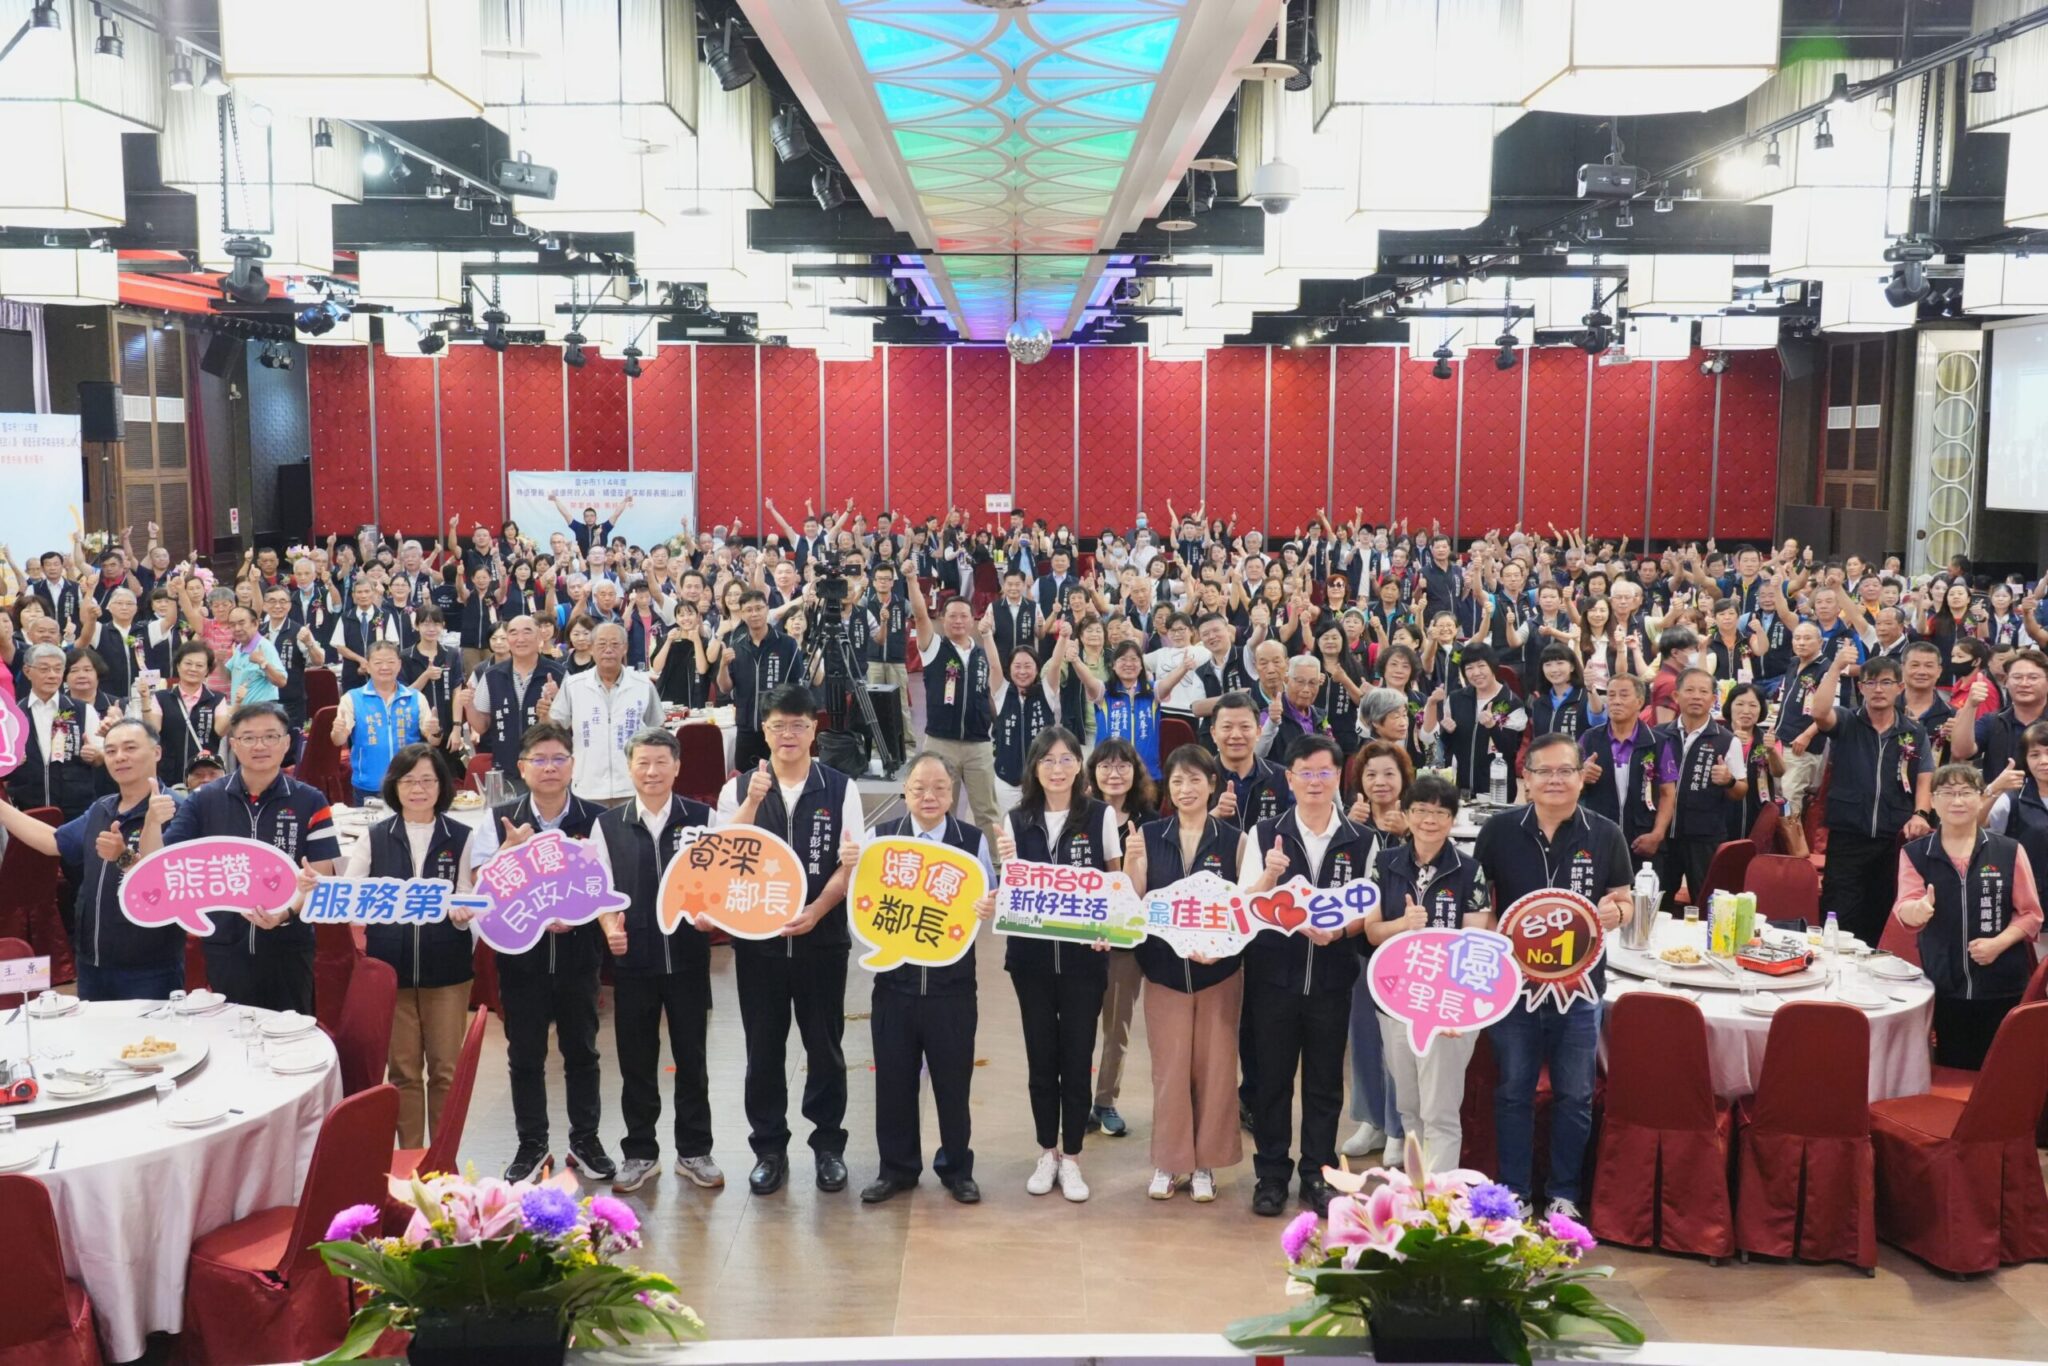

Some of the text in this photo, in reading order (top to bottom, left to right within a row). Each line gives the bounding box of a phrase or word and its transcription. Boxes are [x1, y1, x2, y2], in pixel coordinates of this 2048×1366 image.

[685, 831, 762, 876] 資深
[808, 836, 821, 875] 彭岑凱
[823, 823, 832, 852] 民政局
[163, 853, 252, 900] 熊讚
[485, 836, 565, 898] 績優
[882, 849, 968, 905] 績優
[1005, 862, 1103, 894] 富市台中
[1585, 866, 1594, 897] 民政局
[307, 882, 488, 920] 服務第一
[501, 875, 603, 934] 民政人員
[725, 878, 792, 917] 鄰長
[1010, 887, 1108, 921] 新好生活
[1308, 883, 1377, 929] 台中
[872, 894, 948, 948] 鄰長
[1520, 908, 1573, 939] 台中
[1404, 935, 1506, 993] 特優
[1408, 981, 1467, 1023] 里長
